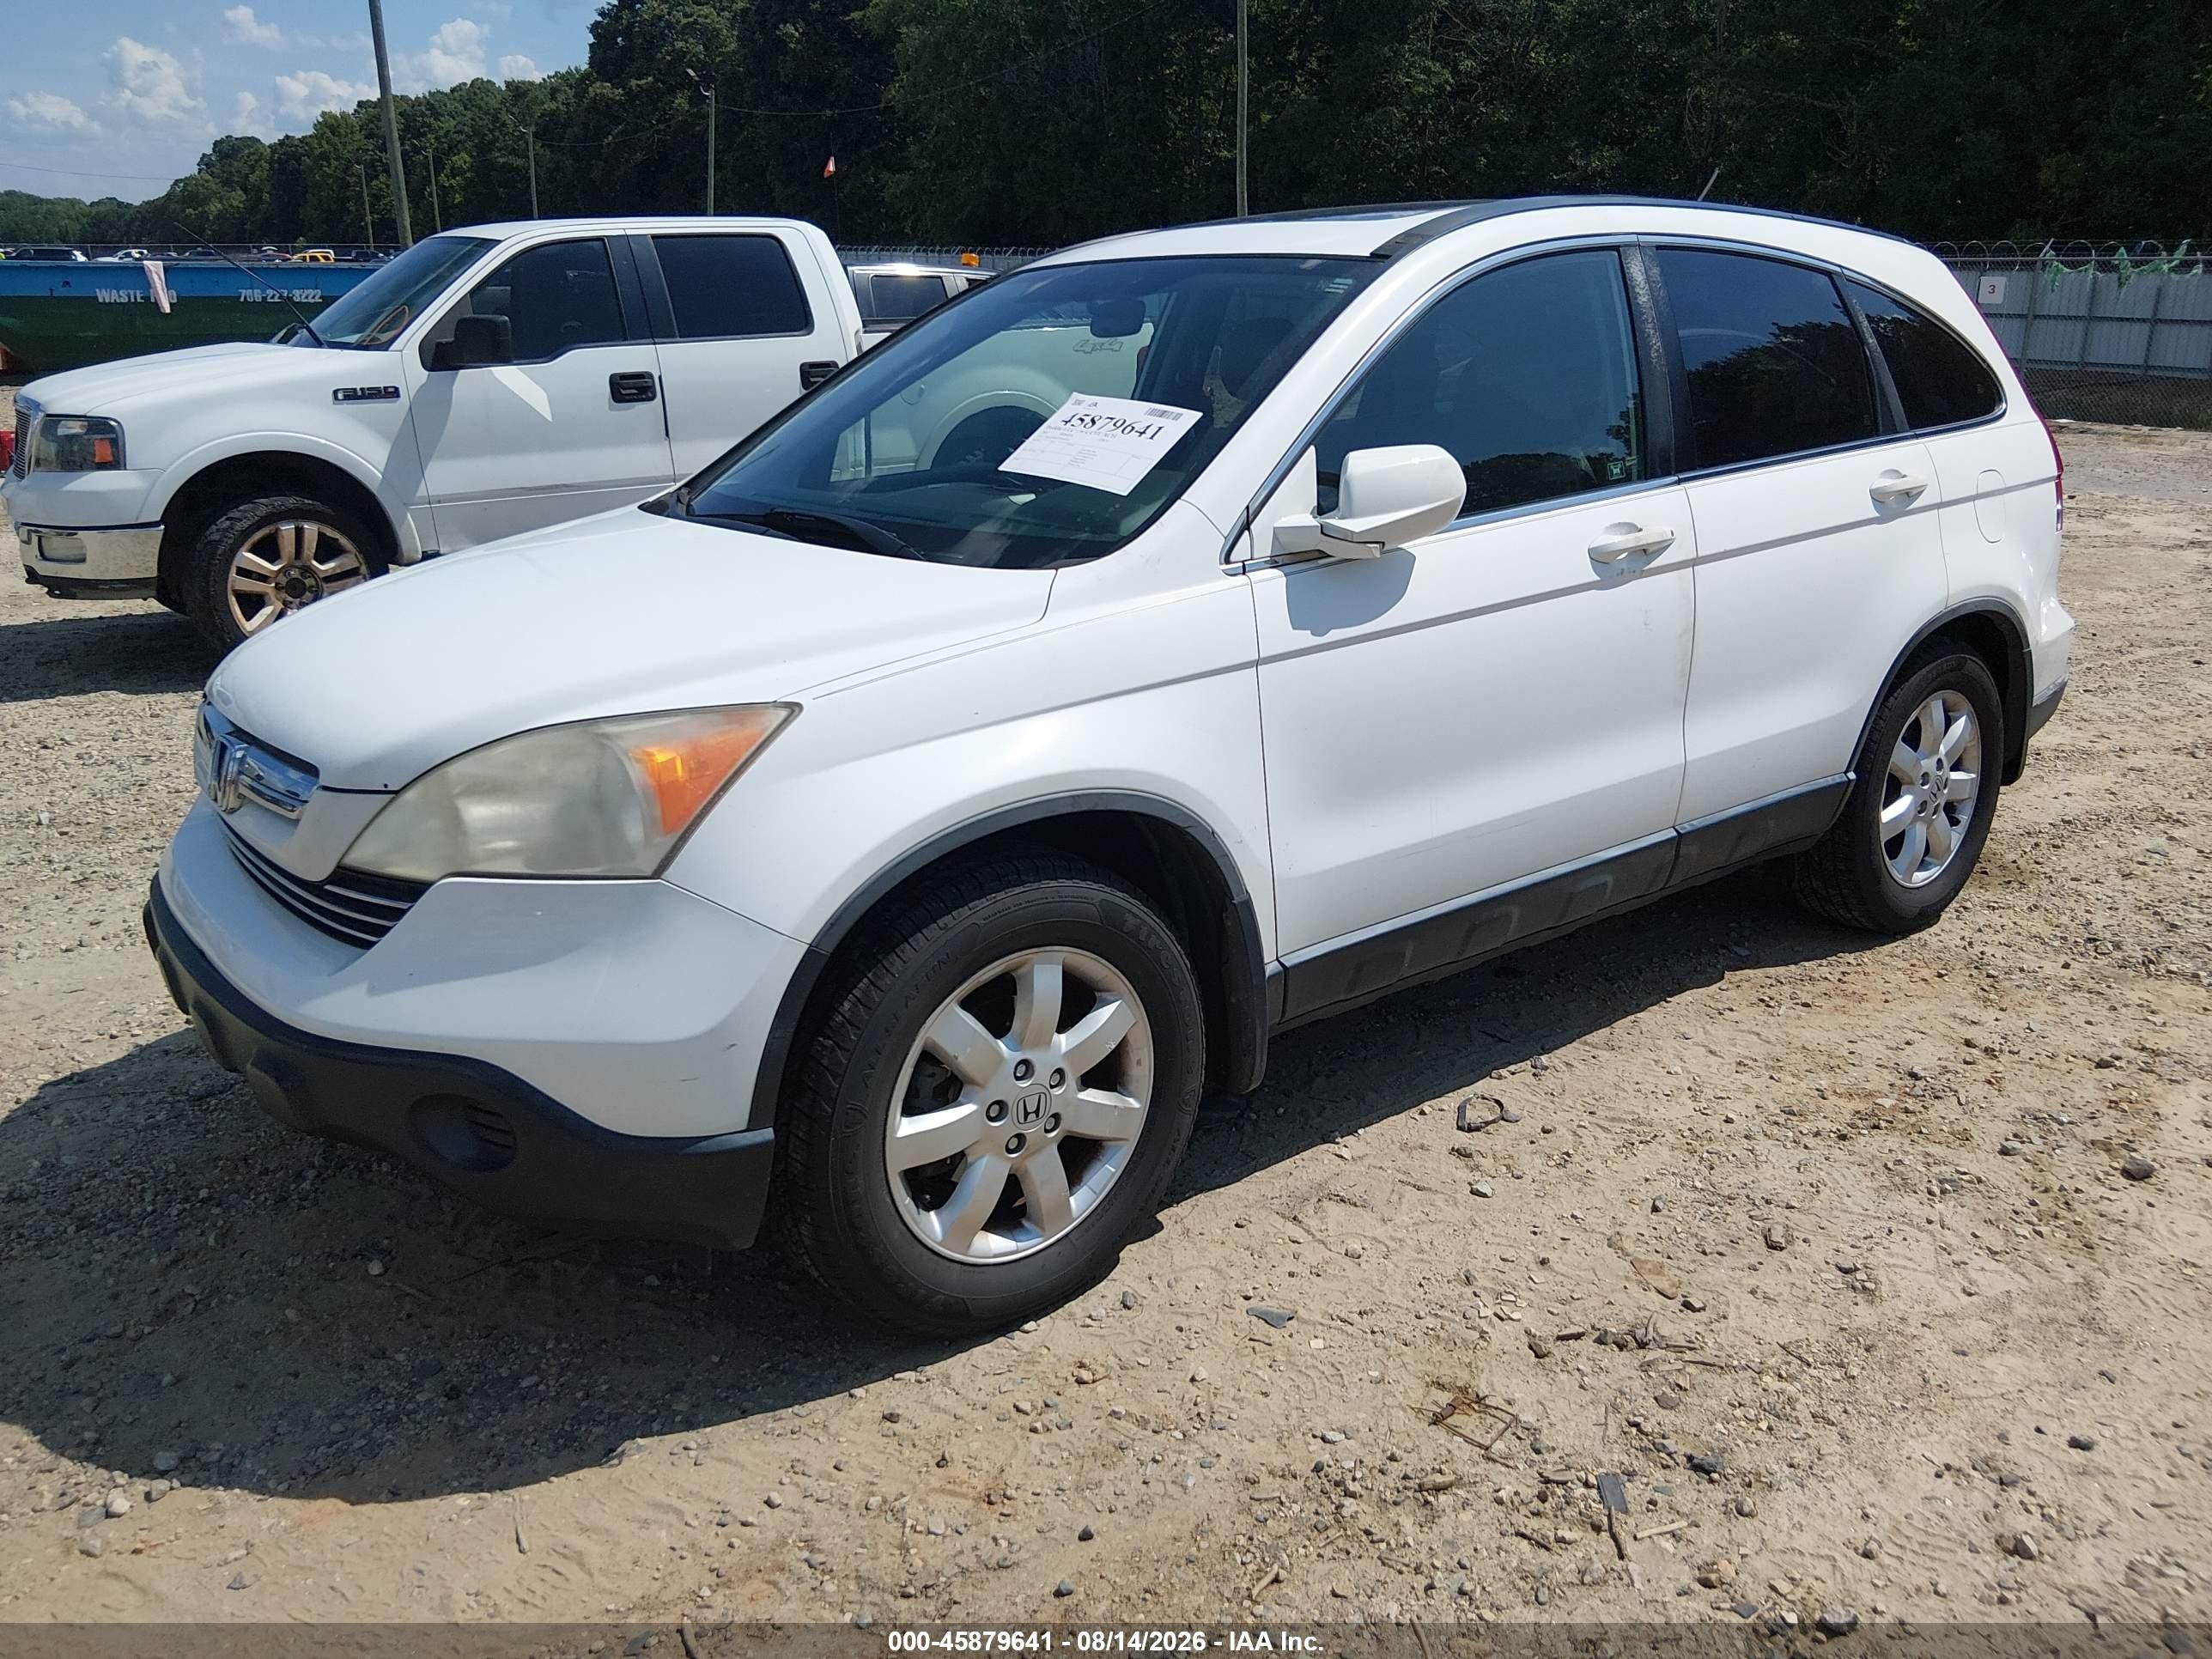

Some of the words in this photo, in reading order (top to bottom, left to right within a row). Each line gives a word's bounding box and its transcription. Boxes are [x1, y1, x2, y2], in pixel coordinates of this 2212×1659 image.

[95, 289, 144, 303] WASTE
[1988, 284, 1996, 295] 3
[1061, 412, 1164, 441] 45879641
